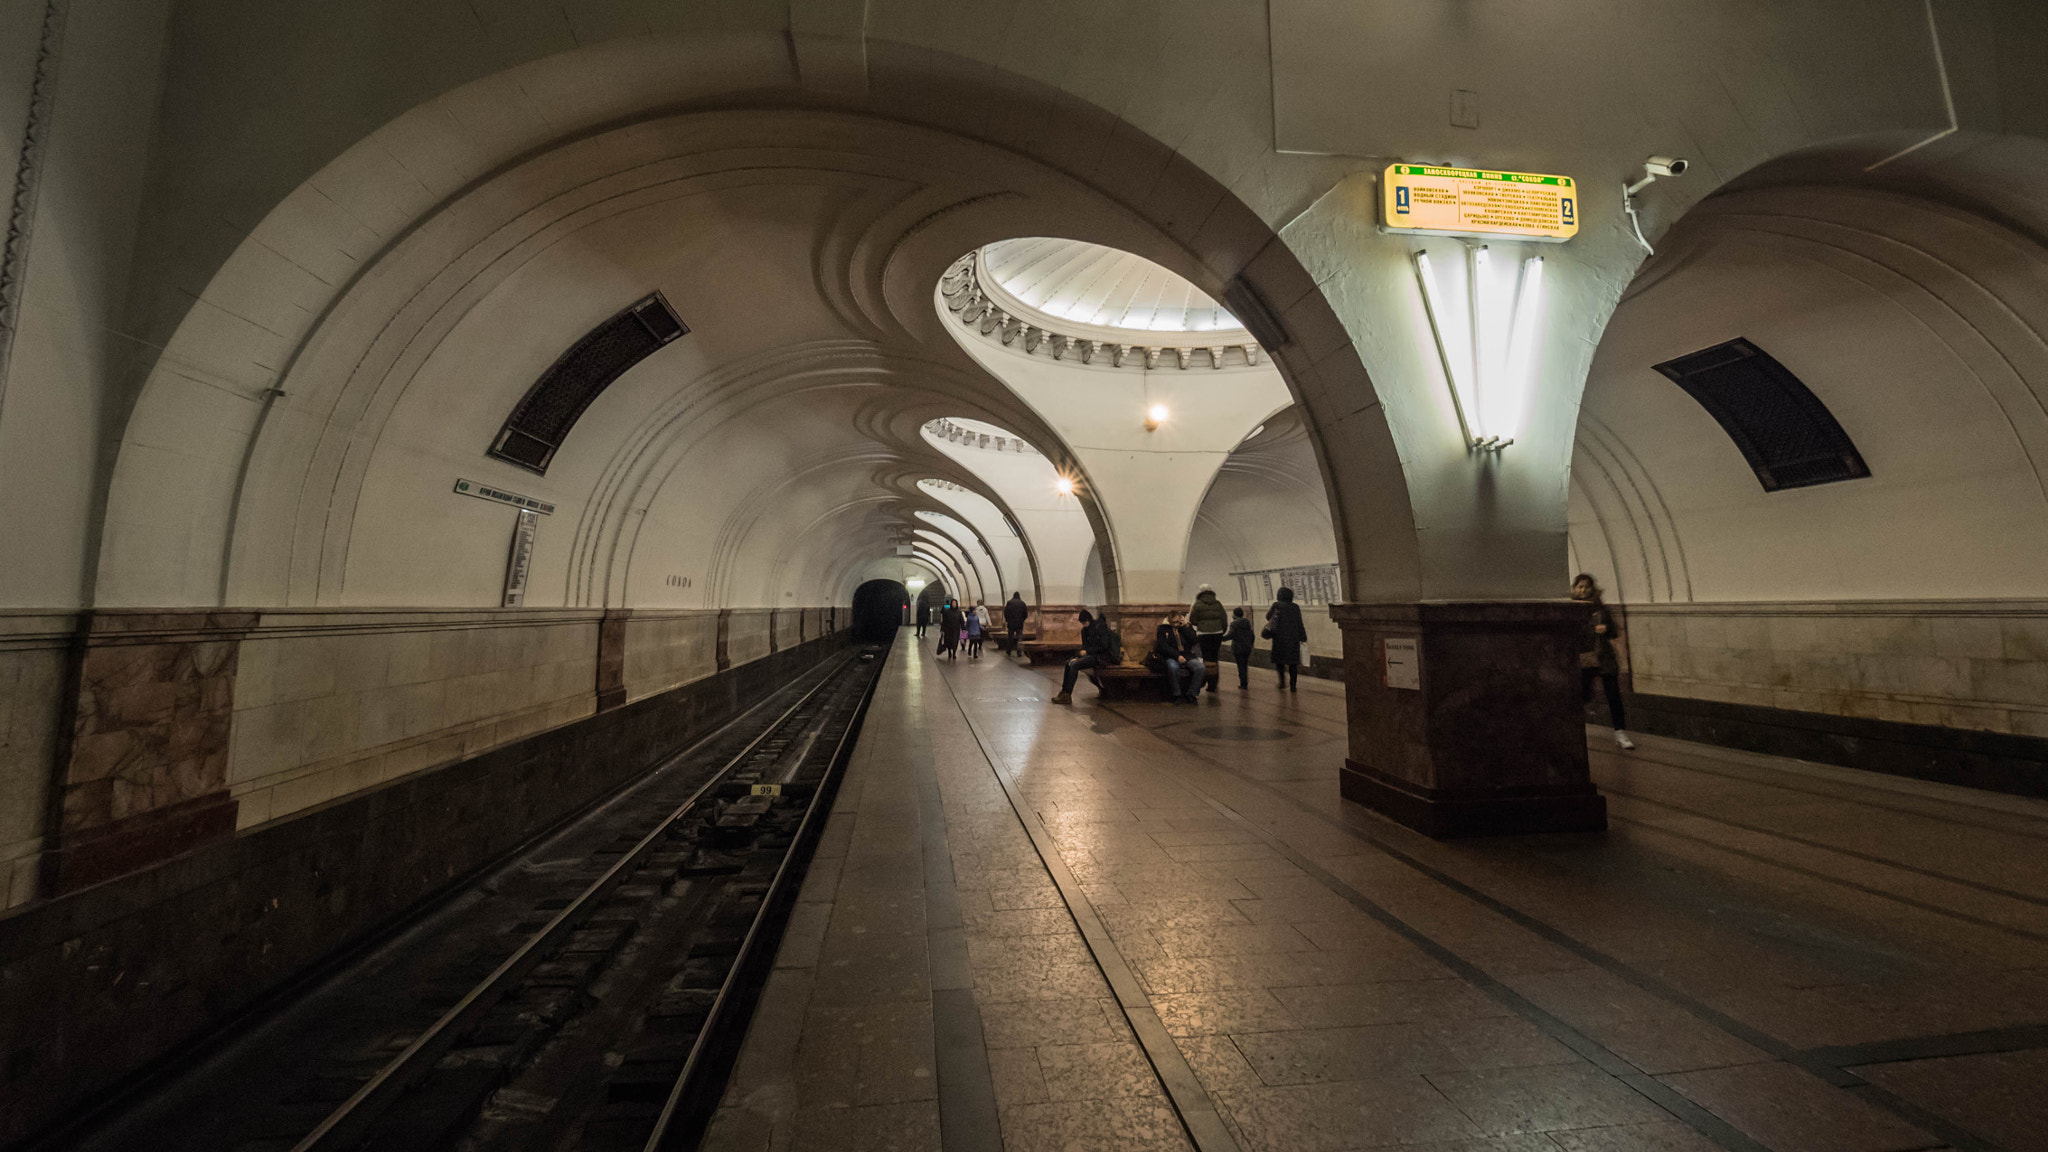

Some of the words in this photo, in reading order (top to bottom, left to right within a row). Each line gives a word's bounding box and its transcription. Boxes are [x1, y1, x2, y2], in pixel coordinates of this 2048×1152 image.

[1399, 190, 1405, 204] 1
[1564, 201, 1571, 215] 2
[760, 786, 772, 794] 99
